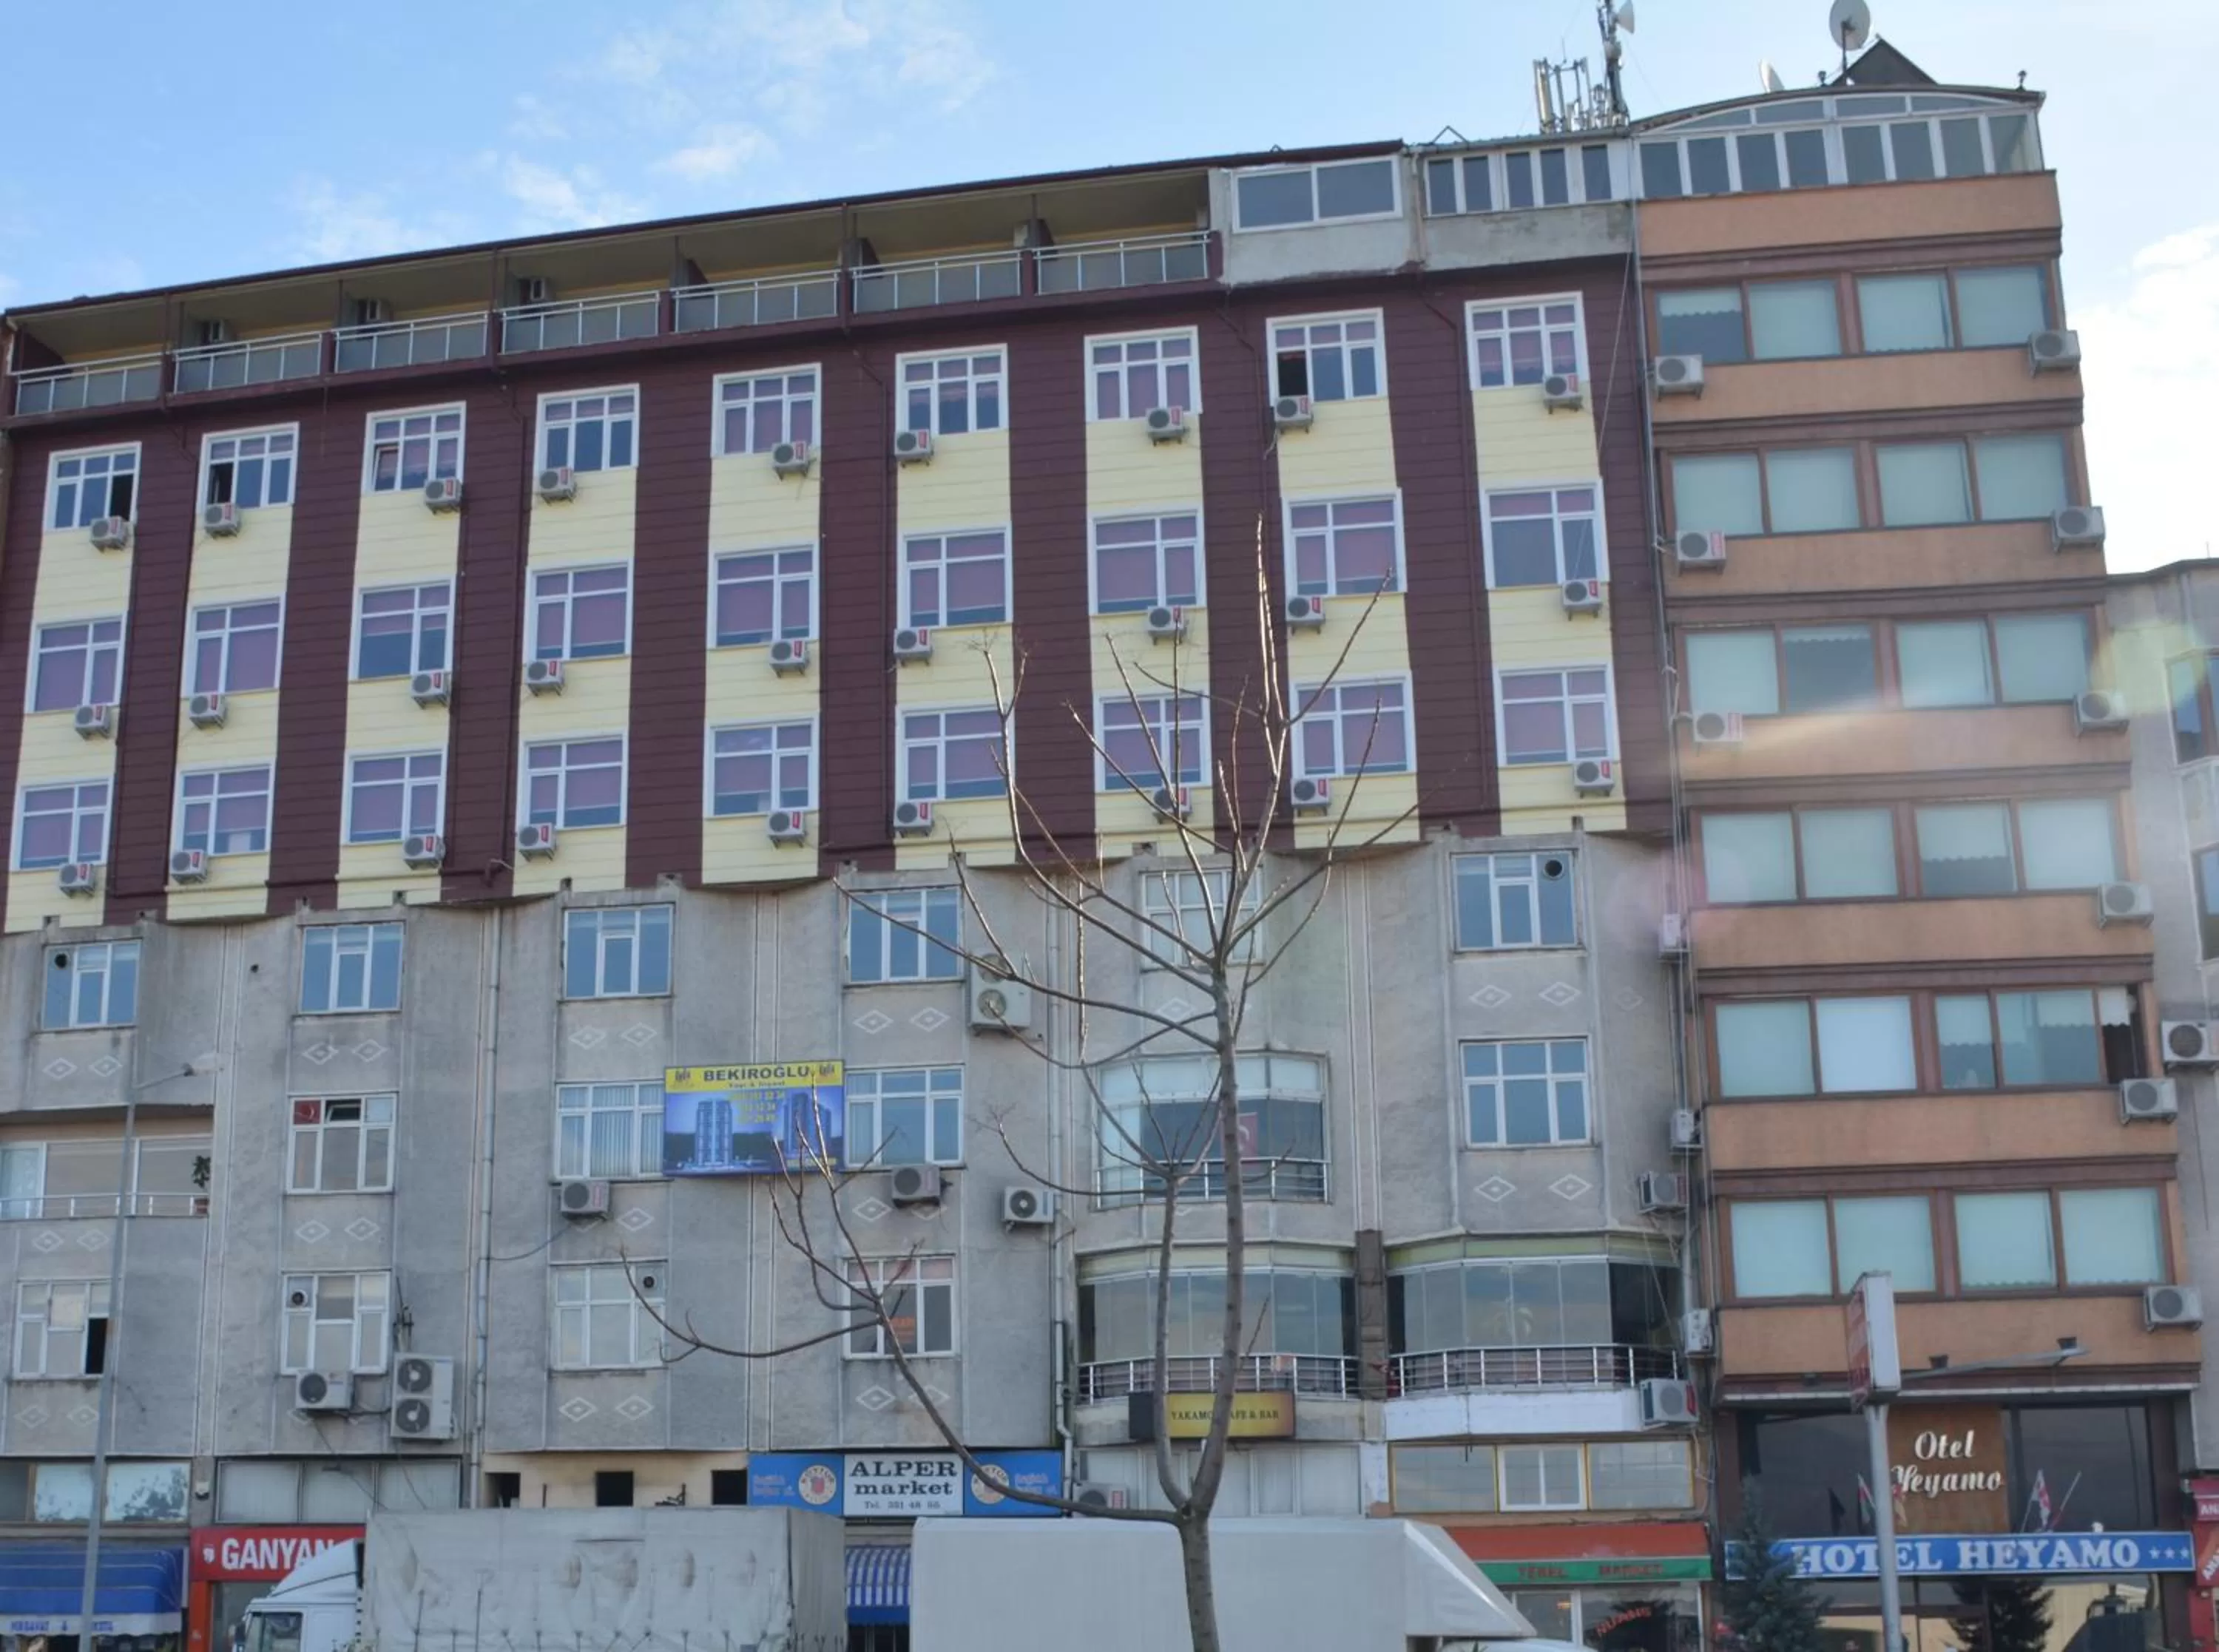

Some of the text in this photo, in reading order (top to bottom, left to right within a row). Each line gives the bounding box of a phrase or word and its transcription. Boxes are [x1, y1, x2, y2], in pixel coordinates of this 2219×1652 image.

[1171, 1410, 1214, 1421] YAKAMO
[1259, 1409, 1279, 1420] BAR
[1914, 1429, 1976, 1460] Otel
[850, 1460, 957, 1477] ALPER
[854, 1480, 953, 1495] market
[1891, 1464, 2003, 1499] Heyamo
[1790, 1538, 2140, 1574] HOTEL HEYAMO
